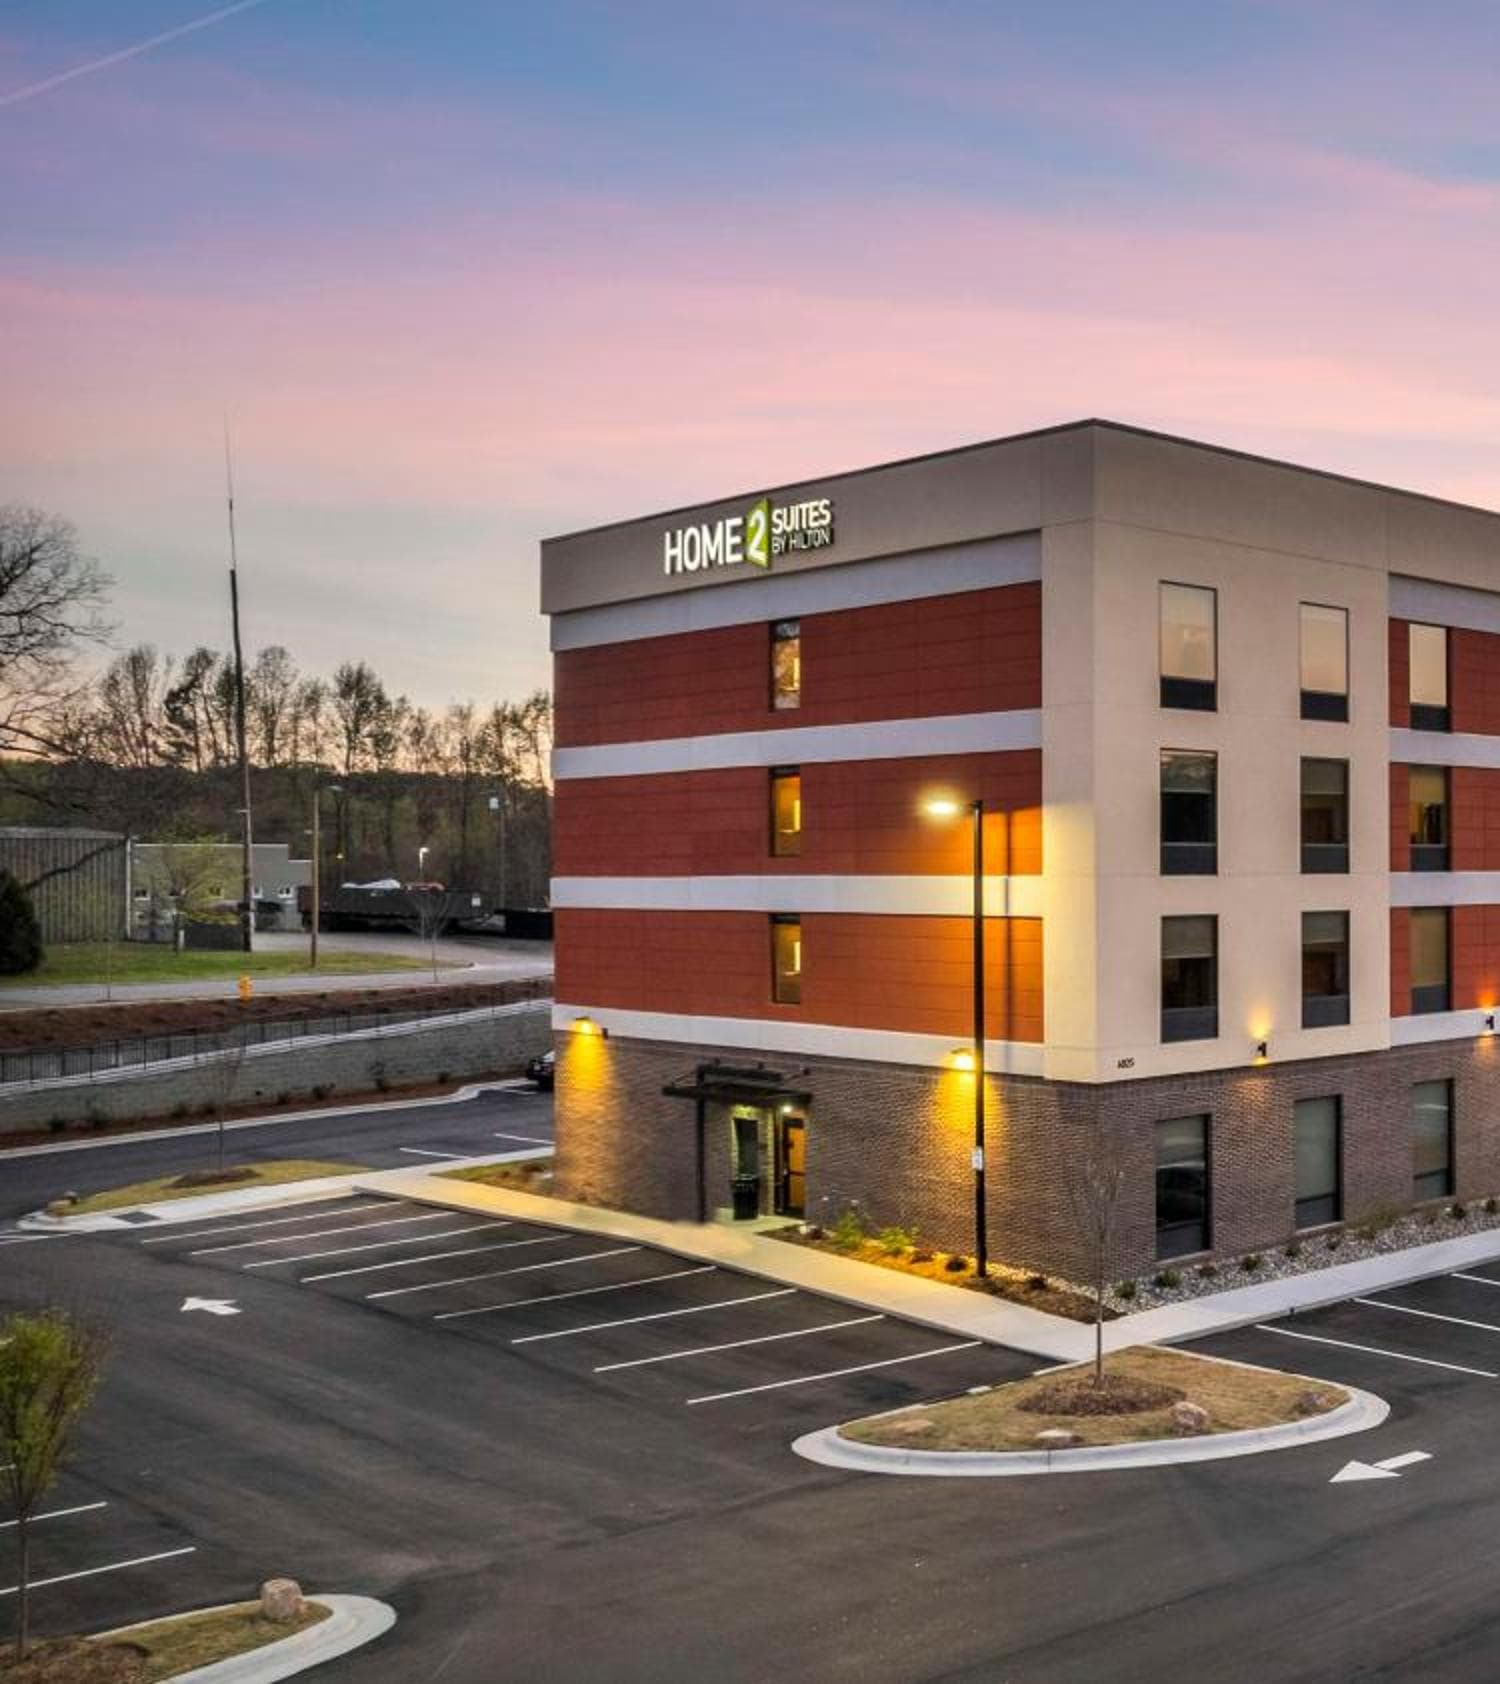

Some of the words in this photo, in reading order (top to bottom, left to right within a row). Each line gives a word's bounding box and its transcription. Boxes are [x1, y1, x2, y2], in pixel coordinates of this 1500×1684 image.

[665, 517, 743, 575] HOME
[747, 507, 768, 567] 2
[772, 499, 831, 534] SUITES
[772, 535, 785, 553] BY
[789, 528, 831, 549] HILTON
